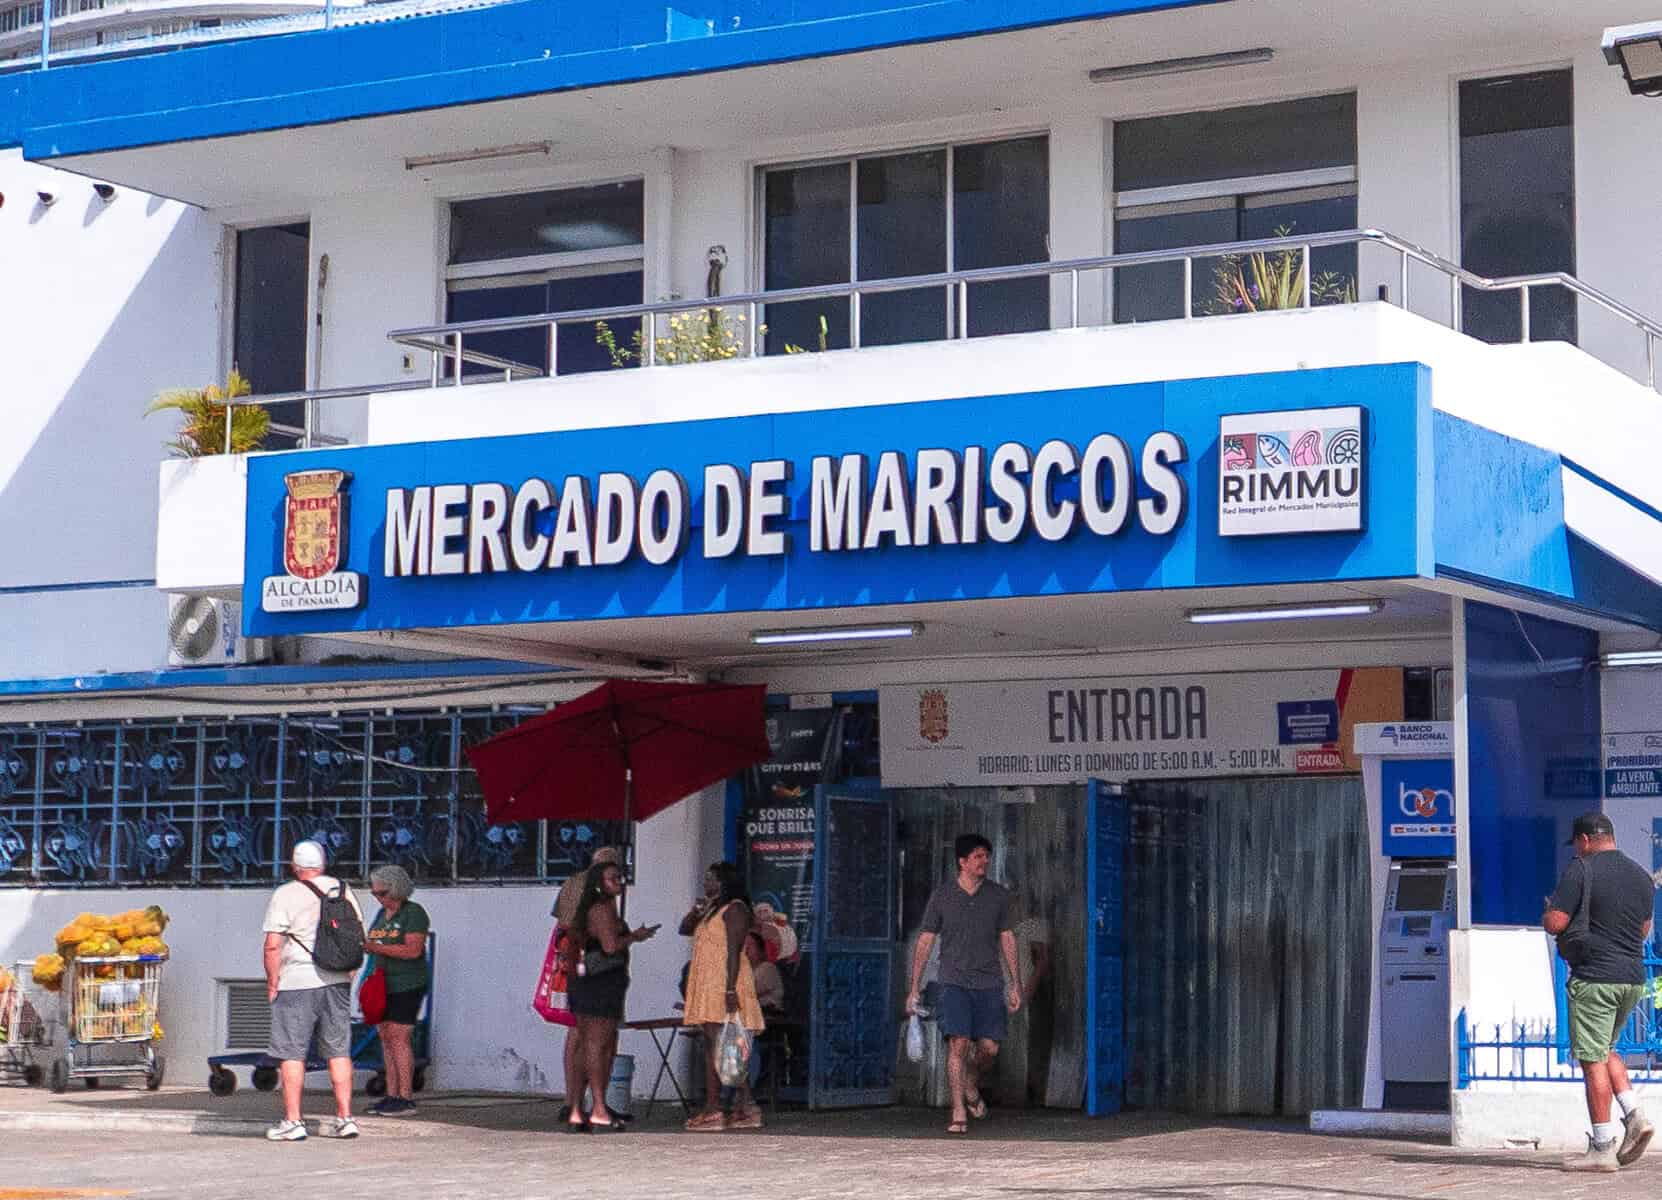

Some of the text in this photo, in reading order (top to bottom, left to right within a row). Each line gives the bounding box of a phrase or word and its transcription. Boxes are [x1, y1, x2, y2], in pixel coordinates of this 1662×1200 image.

[1223, 468, 1359, 503] RIMMU
[384, 430, 1184, 577] MERCADO DE MARISCOS
[1223, 507, 1237, 515] Red
[1238, 505, 1266, 515] Integral
[1278, 503, 1314, 512] Mercados
[1315, 501, 1359, 511] Municipales
[266, 574, 356, 597] ALCALDÍA
[281, 598, 294, 608] DE
[1048, 686, 1207, 743] ENTRADA
[1399, 725, 1433, 733] BANCO
[1399, 733, 1449, 741] NACIONAL
[978, 755, 1033, 774] HORARIO:
[1037, 753, 1071, 773] LUNES
[1074, 753, 1082, 771] A
[1086, 752, 1139, 771] DOMINGO
[1143, 752, 1157, 770] DE
[1161, 751, 1188, 770] 5:00
[1192, 751, 1217, 769] A.M.
[1230, 750, 1258, 769] 5:00
[1261, 749, 1286, 768] P.M.
[1297, 753, 1342, 768] ENTRADA
[1616, 770, 1655, 783] LA VENTA
[1611, 783, 1660, 794] AMBULANTE
[746, 820, 816, 836] QUE BRILL
